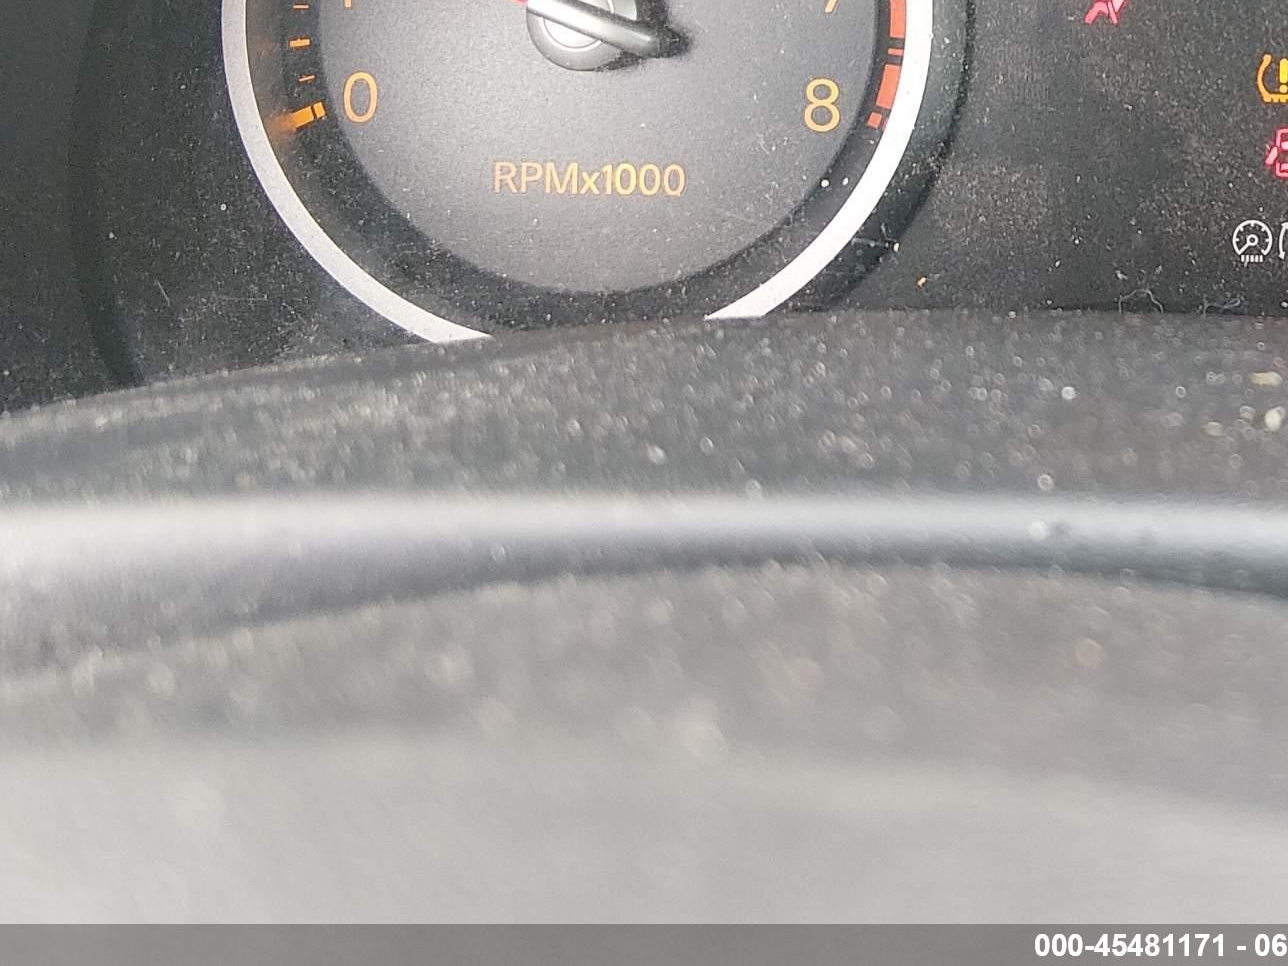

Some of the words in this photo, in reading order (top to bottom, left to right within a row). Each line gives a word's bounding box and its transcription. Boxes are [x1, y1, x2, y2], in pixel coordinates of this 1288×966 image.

[343, 72, 378, 124] 0
[804, 78, 841, 132] 8
[494, 162, 686, 197] RPMx1000
